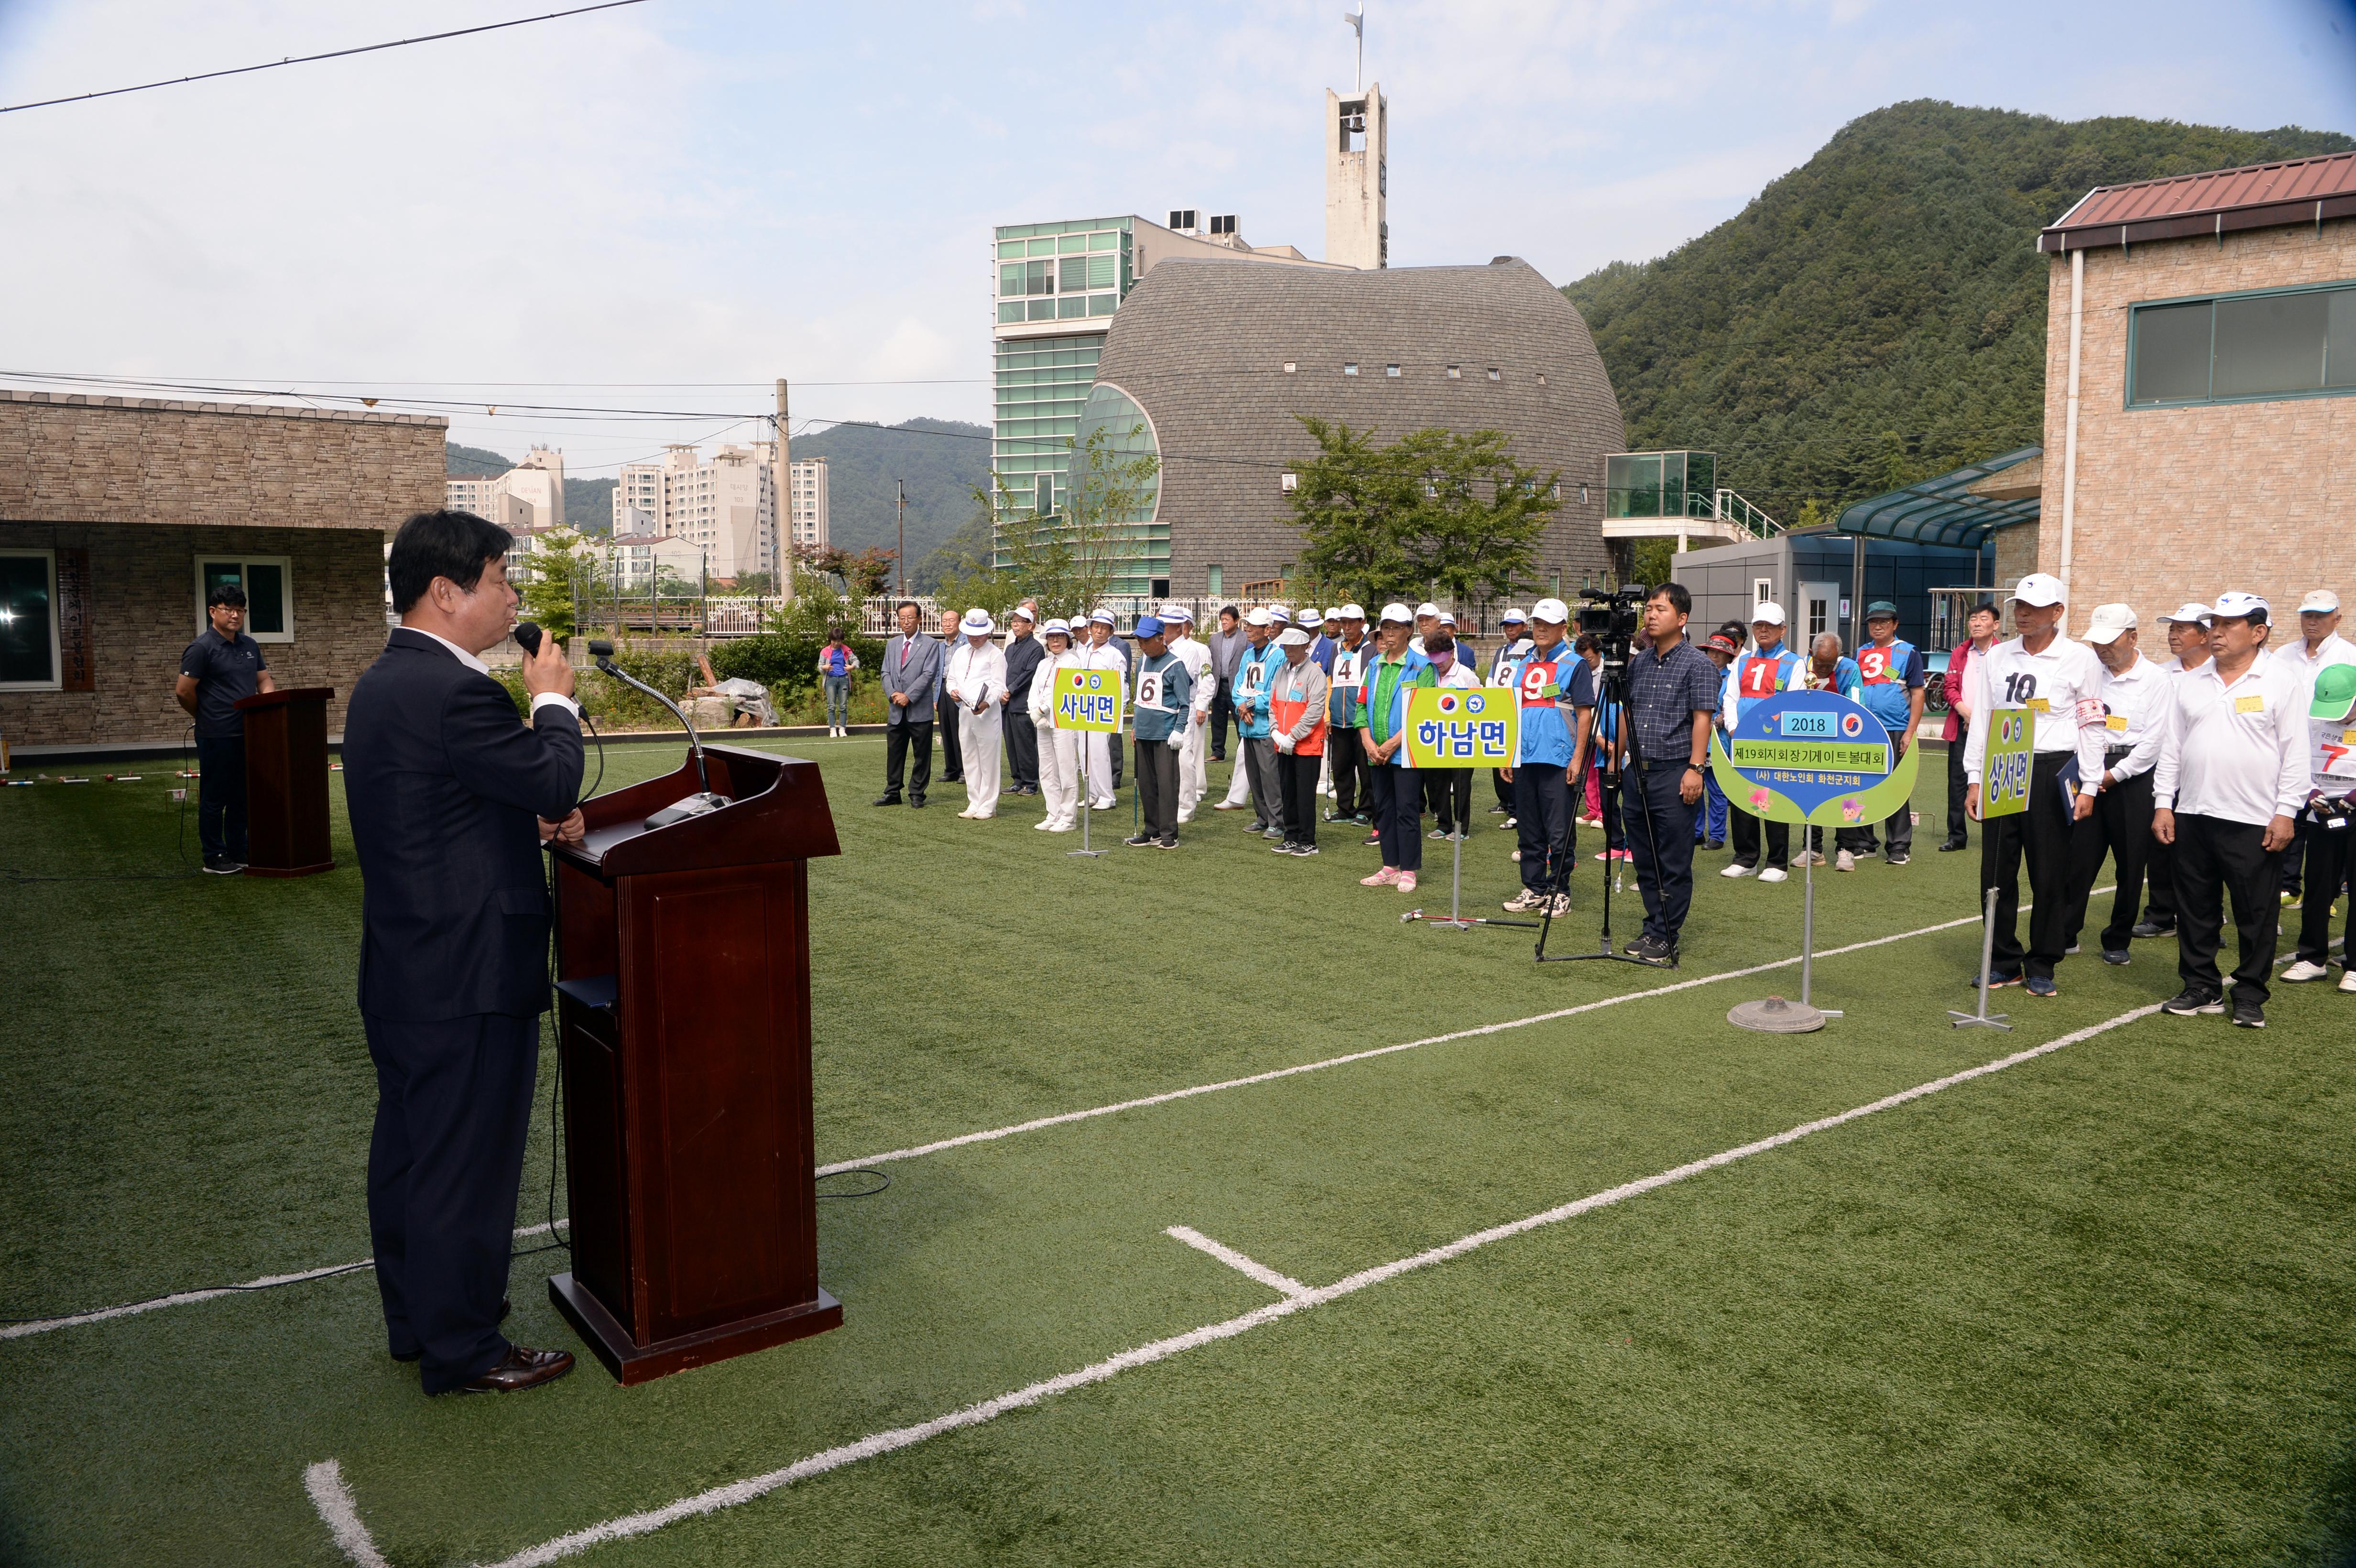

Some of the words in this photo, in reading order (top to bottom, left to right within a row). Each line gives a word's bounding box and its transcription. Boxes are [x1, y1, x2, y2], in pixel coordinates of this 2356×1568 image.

[1246, 666, 1261, 689] 10
[1338, 659, 1352, 679] 4
[1497, 667, 1512, 686] 8
[1751, 663, 1767, 690] 1
[1863, 653, 1884, 678] 3
[1141, 678, 1156, 702] 6
[1524, 667, 1548, 700] 9
[2005, 672, 2037, 704] 10
[1059, 694, 1114, 723] 사내면
[1791, 718, 1825, 731] 2018
[1418, 720, 1505, 756] 하남면
[2320, 743, 2349, 772] 7
[1756, 770, 1770, 781] (사)
[1774, 771, 1813, 784] 대한노인회
[1818, 773, 1861, 786] 화천군지회
[1989, 751, 2028, 802] 상서면
